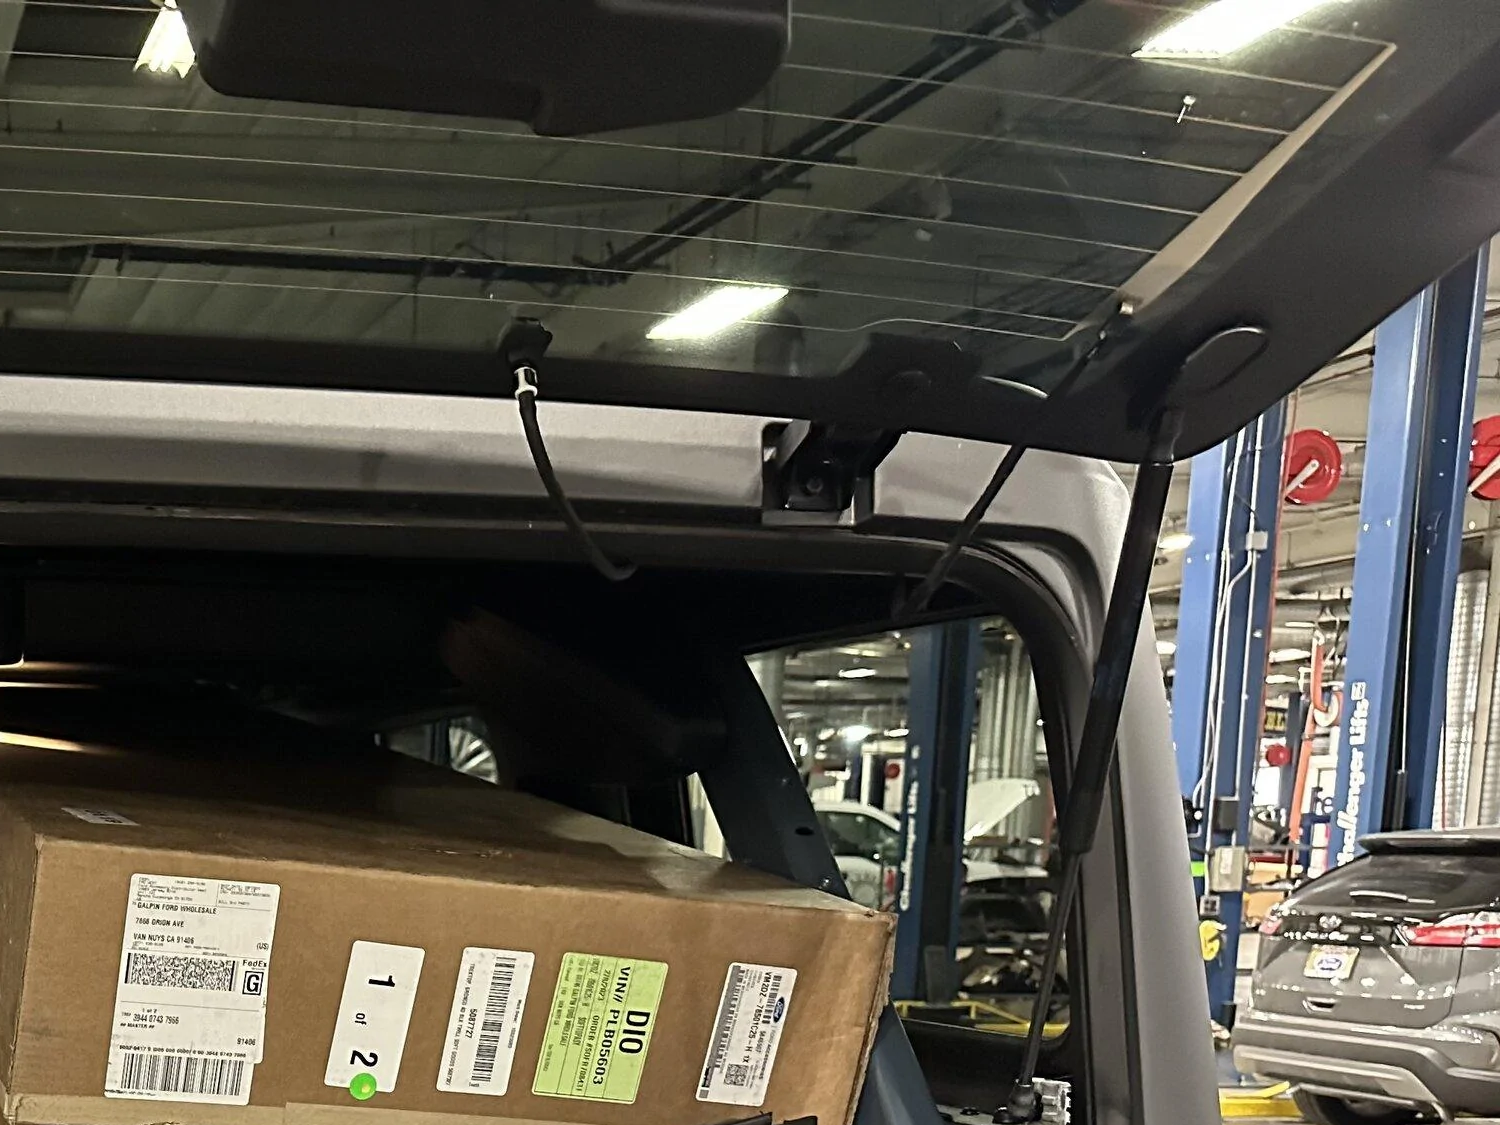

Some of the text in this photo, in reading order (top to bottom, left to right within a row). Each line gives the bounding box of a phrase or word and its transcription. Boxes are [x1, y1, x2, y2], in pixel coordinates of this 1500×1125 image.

[1349, 698, 1369, 745] Lifts
[180, 906, 216, 914] WHOLESALE
[172, 920, 184, 928] AVE
[148, 934, 165, 942] NUYS
[166, 935, 175, 943] CA
[177, 936, 194, 944] 91406
[246, 974, 259, 992] G
[350, 975, 395, 1067] 1 of 2
[588, 1015, 600, 1041] ORDER
[619, 1011, 650, 1053] DIO
[237, 1038, 256, 1046] 91406
[593, 1010, 620, 1084] PLB05603
